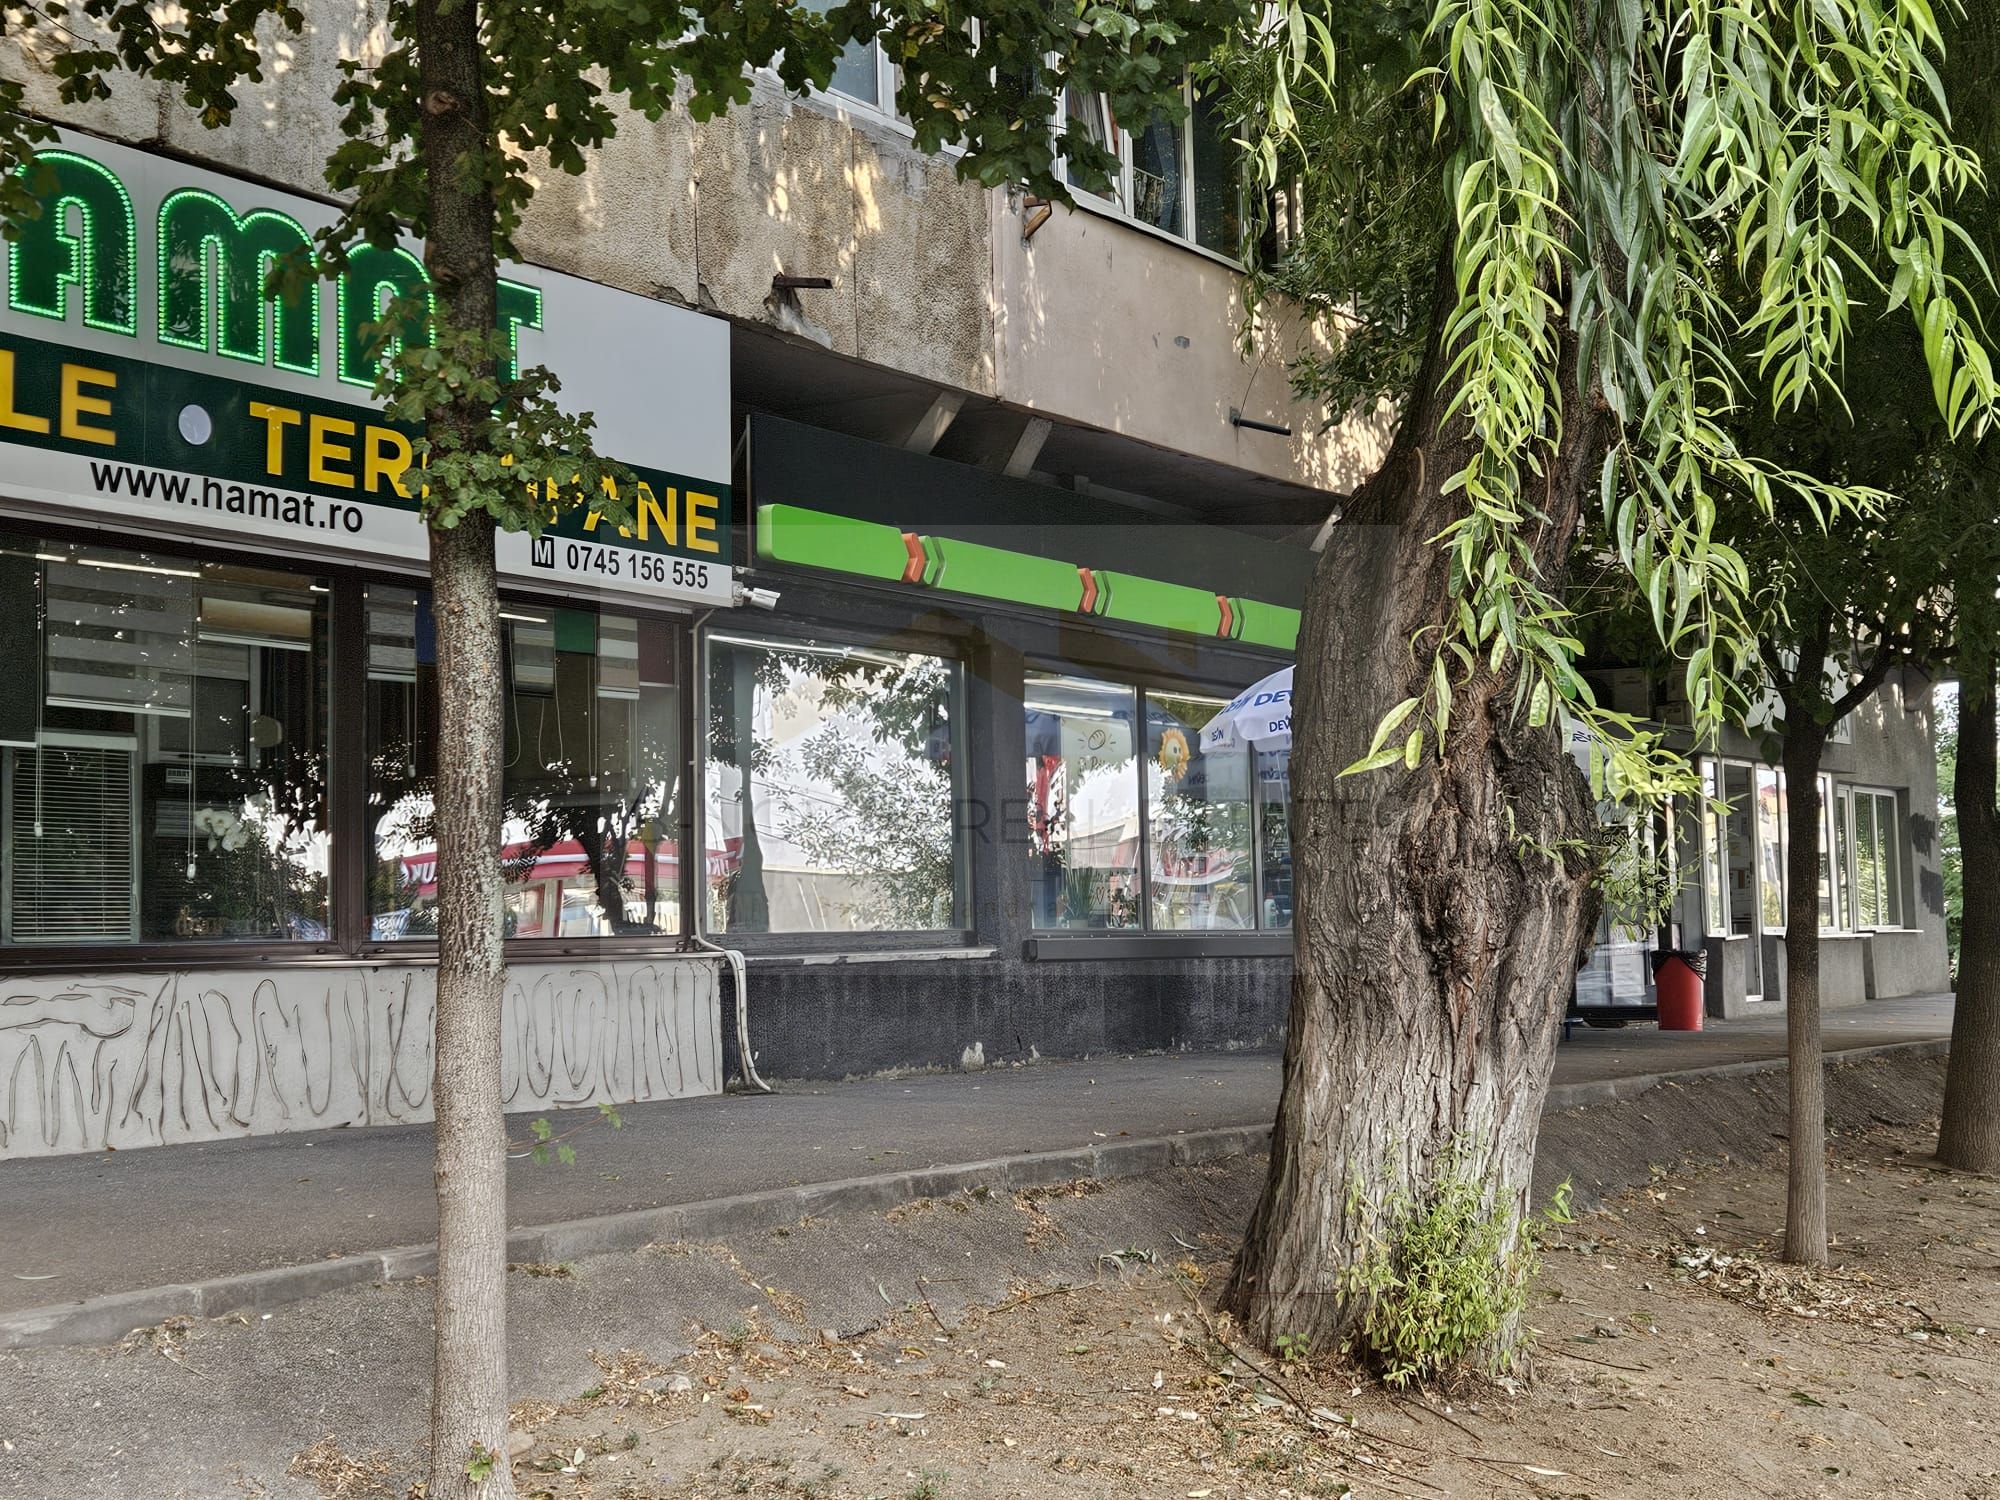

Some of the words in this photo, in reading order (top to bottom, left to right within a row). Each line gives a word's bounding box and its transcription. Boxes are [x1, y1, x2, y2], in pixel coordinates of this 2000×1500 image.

[89, 461, 364, 534] www.hamat.ro
[567, 544, 620, 575] 0745
[627, 553, 665, 583] 156
[671, 560, 709, 590] 555
